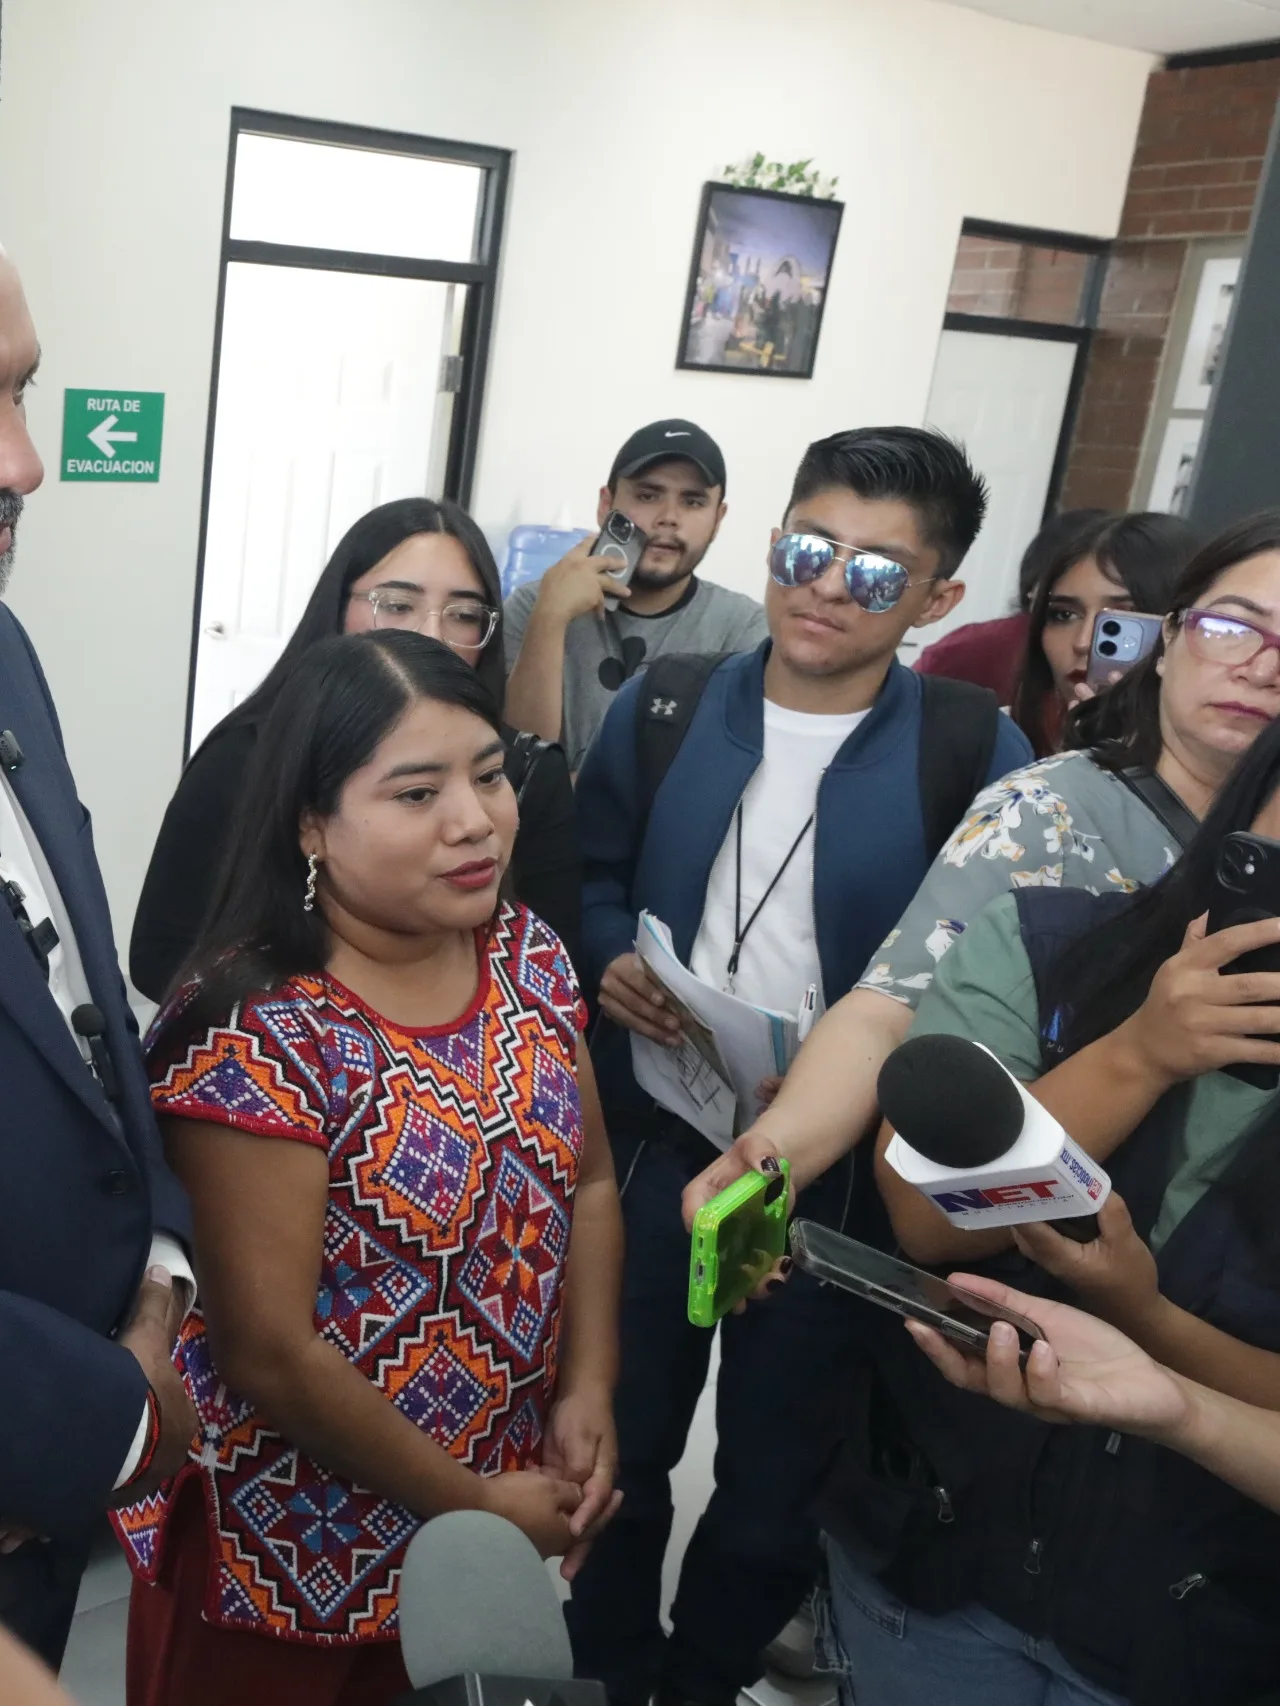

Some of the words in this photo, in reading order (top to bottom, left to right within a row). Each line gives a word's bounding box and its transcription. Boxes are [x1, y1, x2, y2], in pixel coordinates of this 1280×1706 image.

[86, 398, 120, 411] RUTA
[123, 399, 141, 412] DE
[66, 459, 154, 473] EVACUACION
[931, 1180, 1059, 1213] NET
